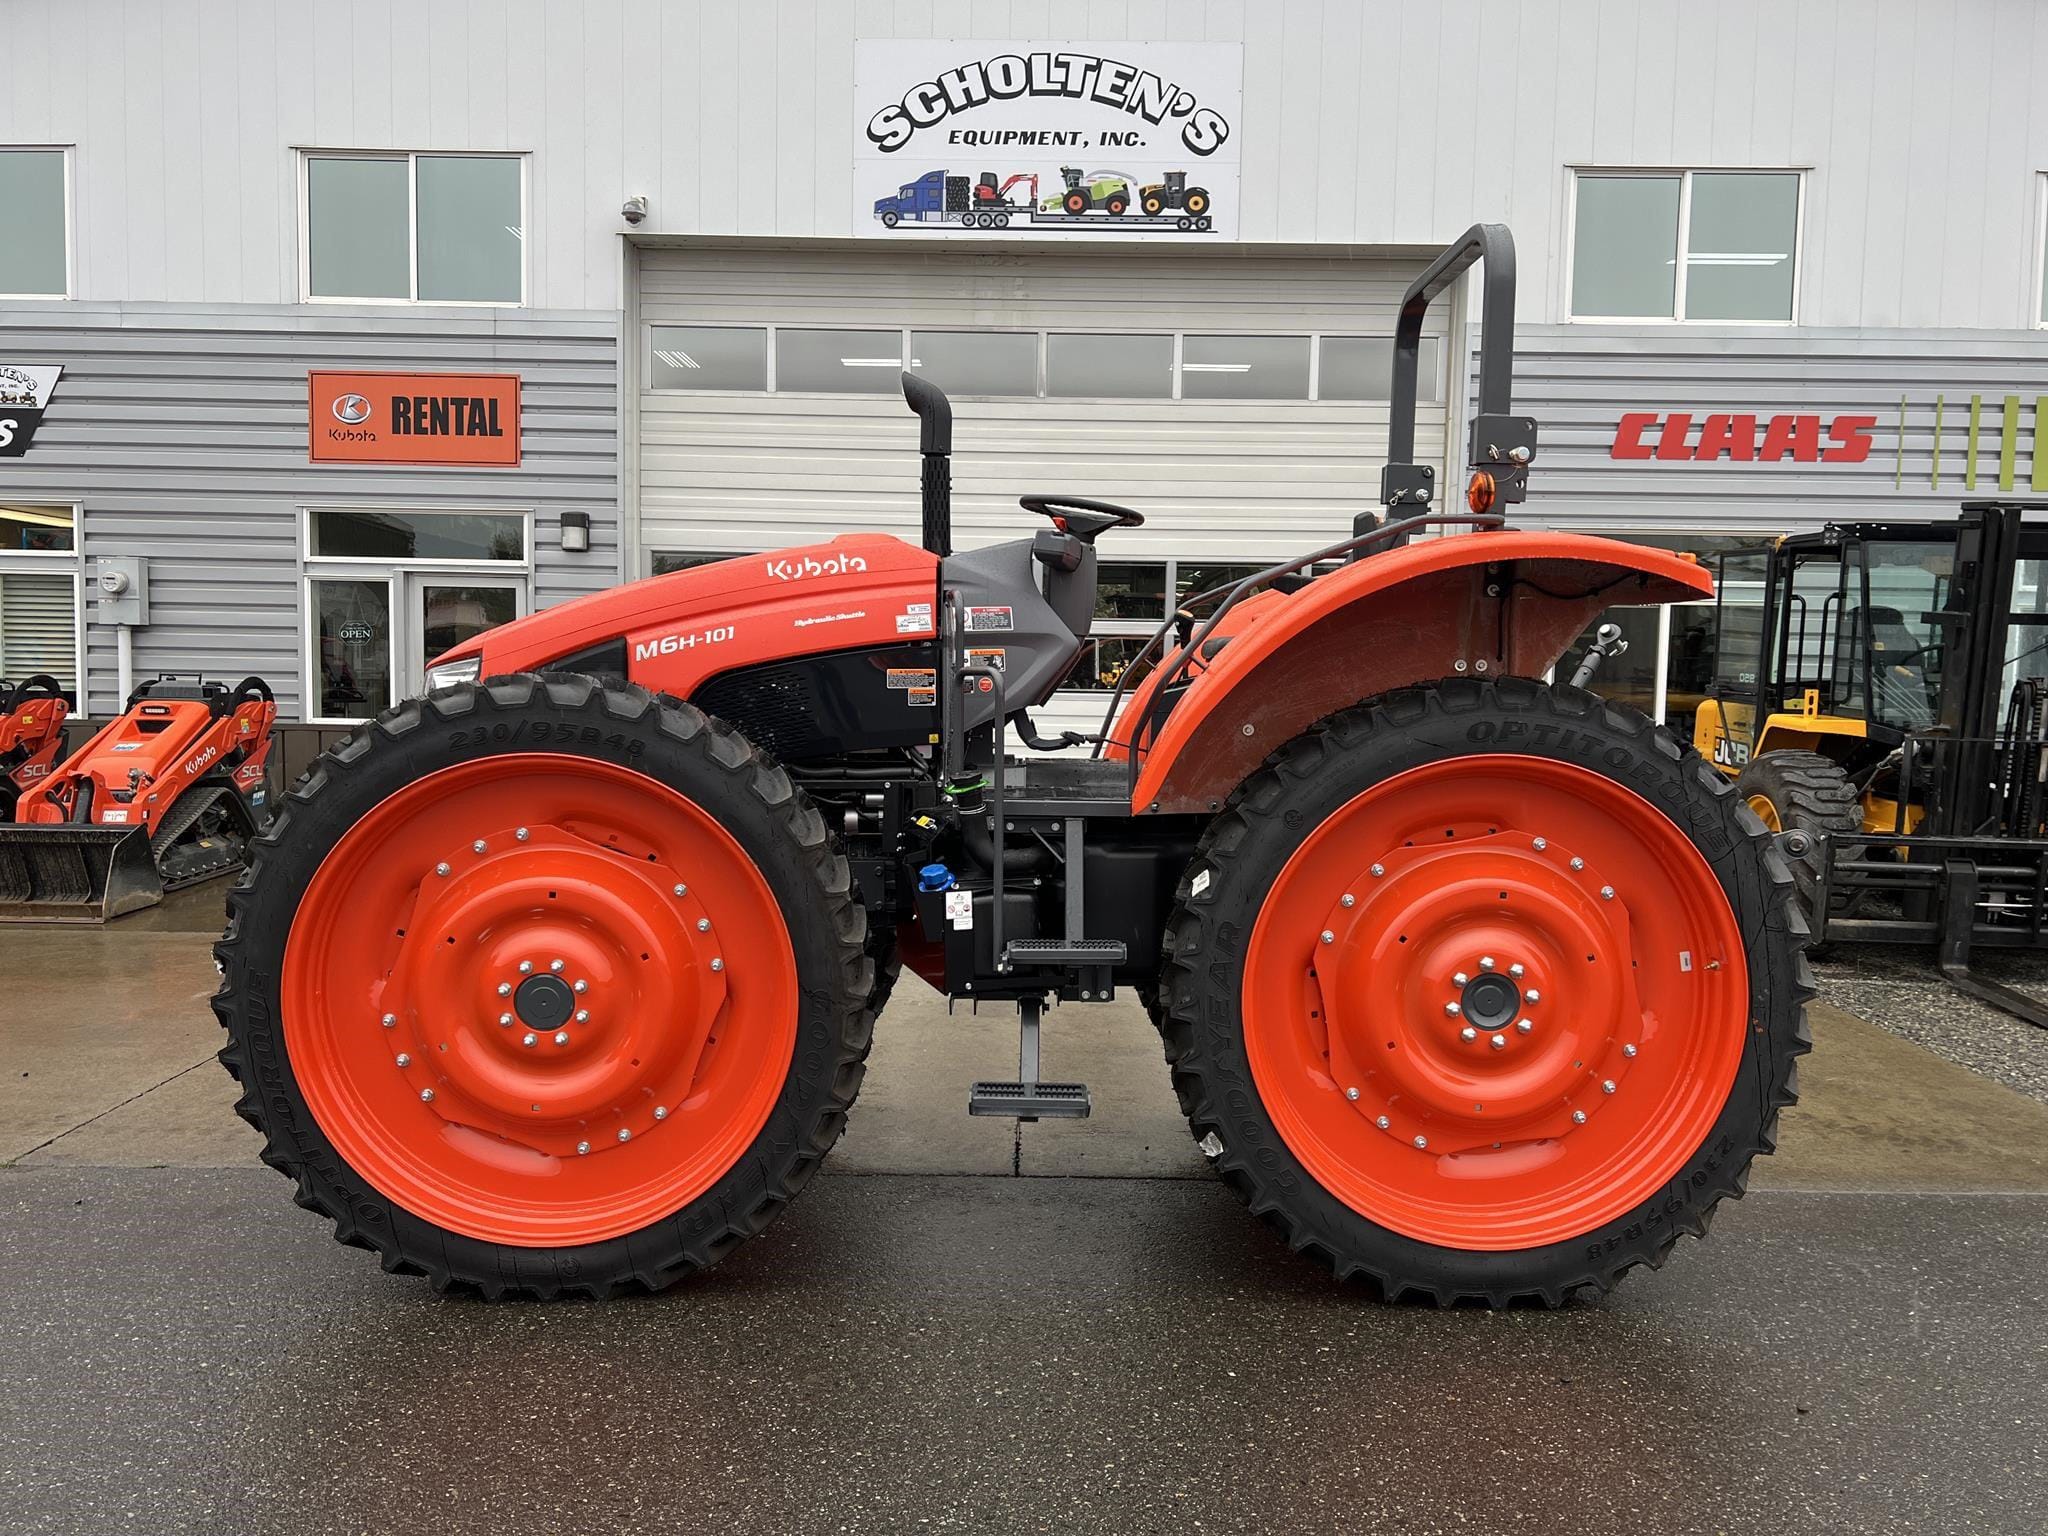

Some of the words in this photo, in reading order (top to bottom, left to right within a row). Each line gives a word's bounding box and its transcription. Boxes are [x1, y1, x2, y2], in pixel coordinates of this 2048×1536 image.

[866, 52, 1230, 156] SCHOLTEN'S
[948, 129, 1090, 148] EQUIPMENT,
[1099, 131, 1147, 147] INC.
[391, 396, 503, 437] RENTAL
[328, 428, 377, 442] Kubota
[1610, 412, 1878, 463] CLAAS
[766, 553, 867, 581] Kubota
[340, 629, 371, 639] OPEN
[635, 626, 736, 662] M6H-101
[185, 745, 217, 776] Kubota
[1714, 738, 1750, 765] JCB
[22, 763, 51, 778] SCL
[240, 764, 264, 778] SCL
[1465, 719, 1734, 854] OPTITORQUE
